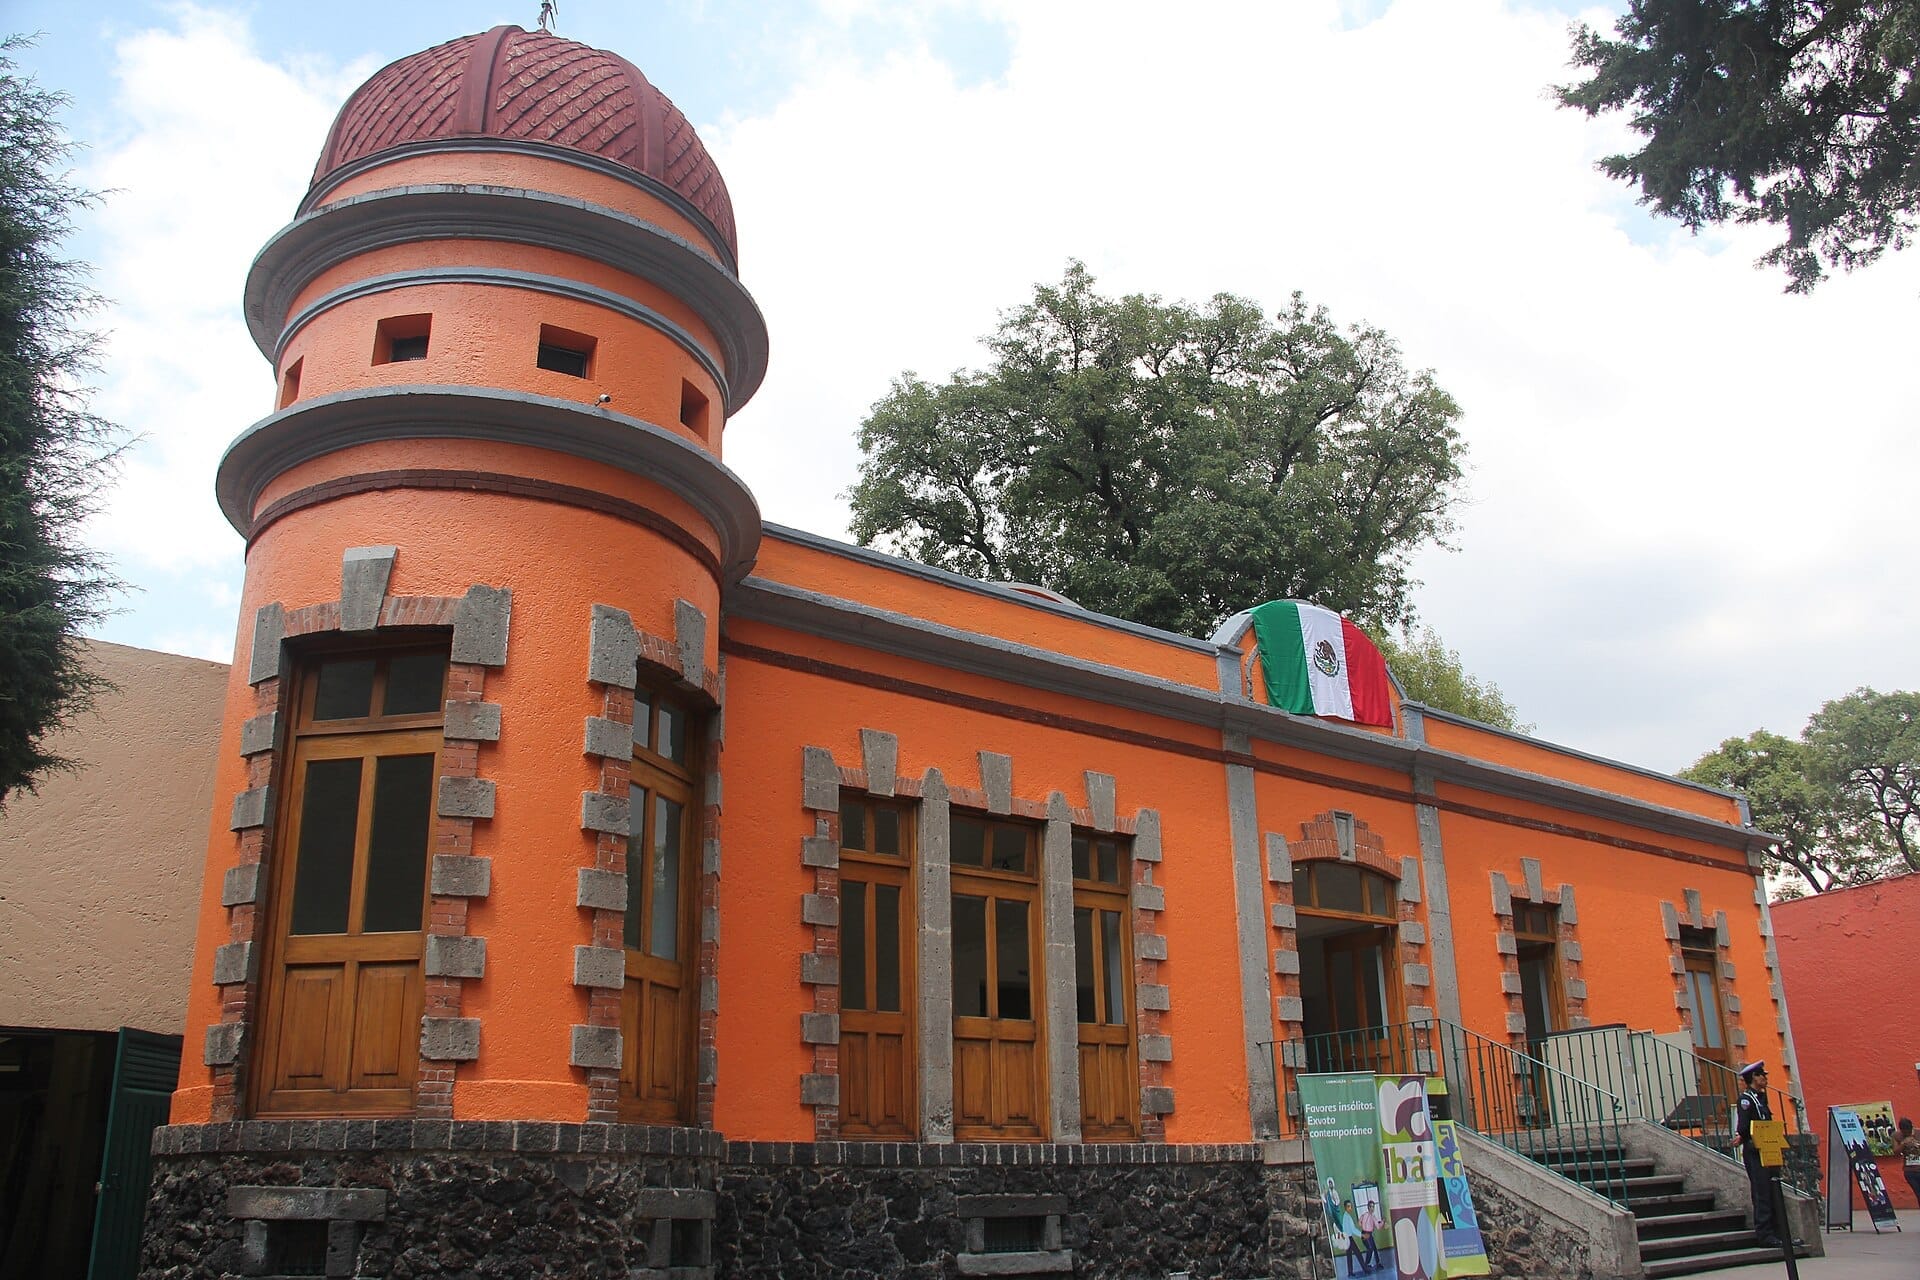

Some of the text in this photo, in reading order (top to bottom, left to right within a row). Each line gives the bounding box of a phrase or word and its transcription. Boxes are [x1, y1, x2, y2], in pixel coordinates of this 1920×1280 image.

[1305, 1100, 1375, 1113] Favores insólitos.
[1307, 1116, 1336, 1126] Exvoto
[1309, 1125, 1373, 1140] contemporáneo
